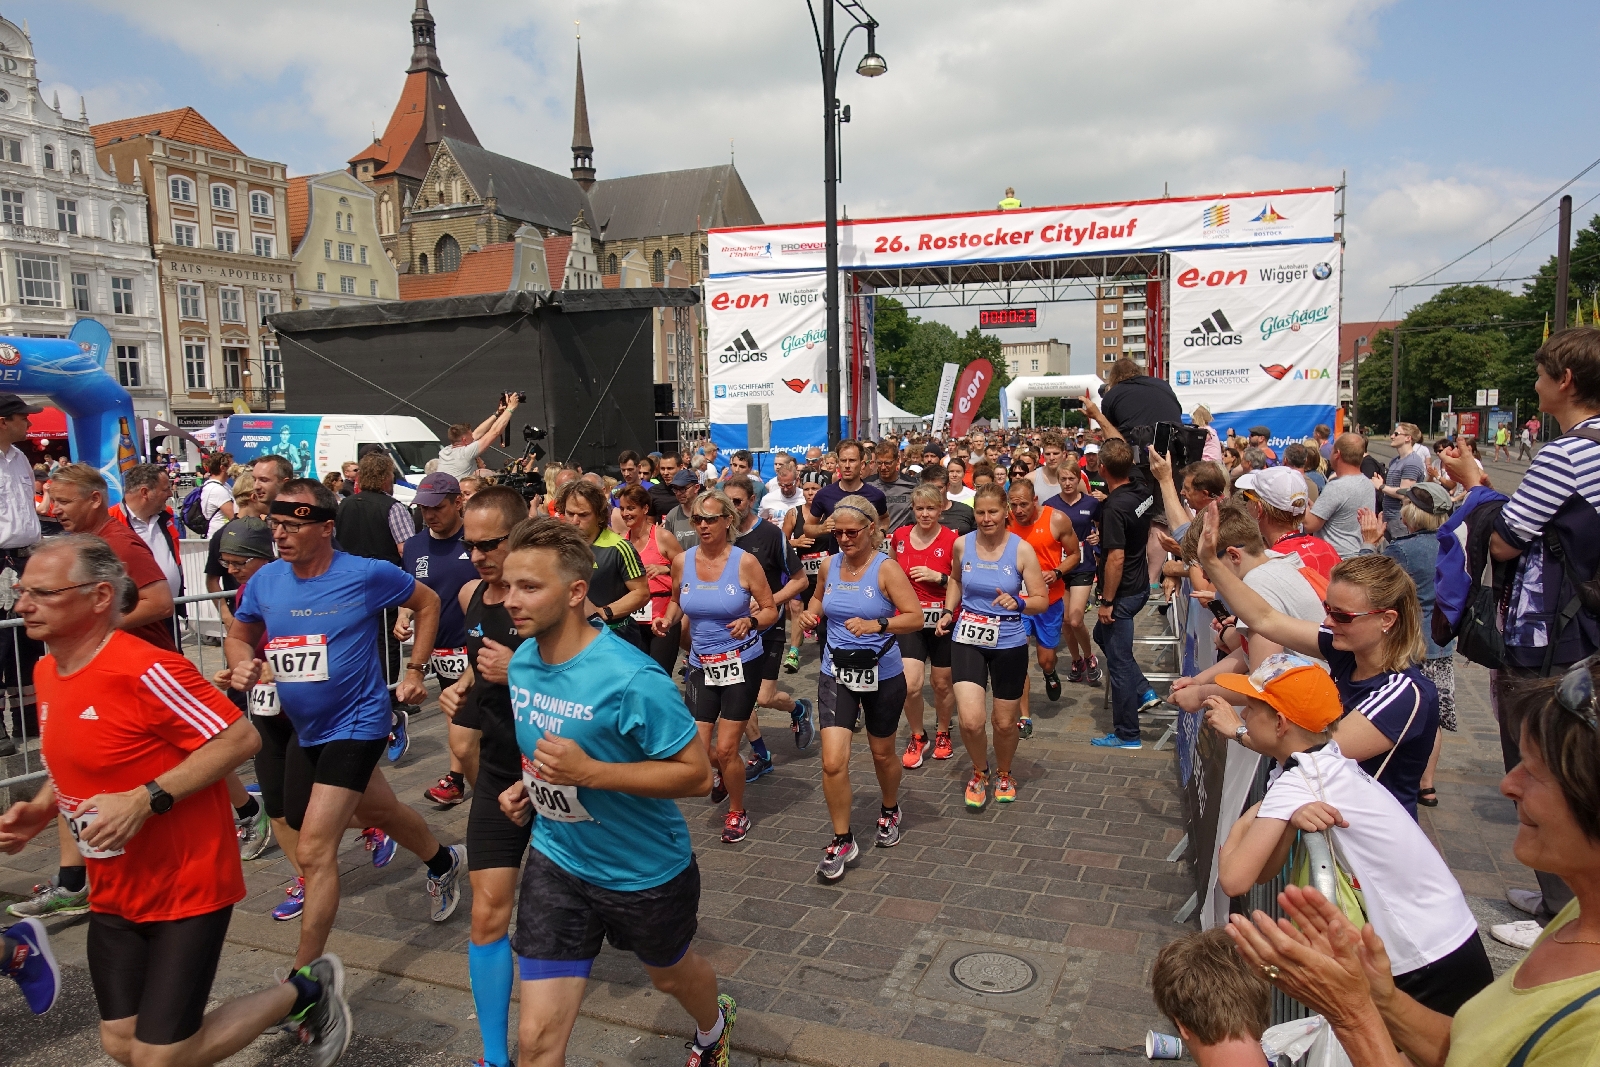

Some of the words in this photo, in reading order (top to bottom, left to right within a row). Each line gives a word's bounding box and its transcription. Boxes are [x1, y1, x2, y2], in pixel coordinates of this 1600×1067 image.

[874, 236, 910, 253] 26.
[918, 229, 1033, 251] Rostocker
[1040, 218, 1138, 246] Citylauf
[170, 261, 202, 275] RATS
[220, 268, 283, 283] APOTHEKE
[1260, 269, 1308, 283] Wigger
[778, 291, 819, 306] Wigger
[1260, 305, 1331, 341] Glashäger
[1184, 333, 1243, 347] adidas
[719, 350, 768, 364] adidas
[1205, 368, 1250, 377] SCHIFFAHRT
[1293, 368, 1331, 380] AIDA
[738, 382, 775, 390] SCHIFFAHRT
[1193, 377, 1218, 385] HAFEN
[1219, 376, 1250, 384] ROSTOCK
[749, 389, 775, 397] ROSTOCK
[961, 624, 995, 641] 1573
[270, 651, 321, 673] 1677
[434, 658, 464, 673] 1623
[705, 662, 740, 679] 1575
[835, 668, 875, 684] 1579
[533, 692, 594, 721] RUNNERS
[529, 710, 565, 735] POINT
[531, 781, 571, 813] 300
